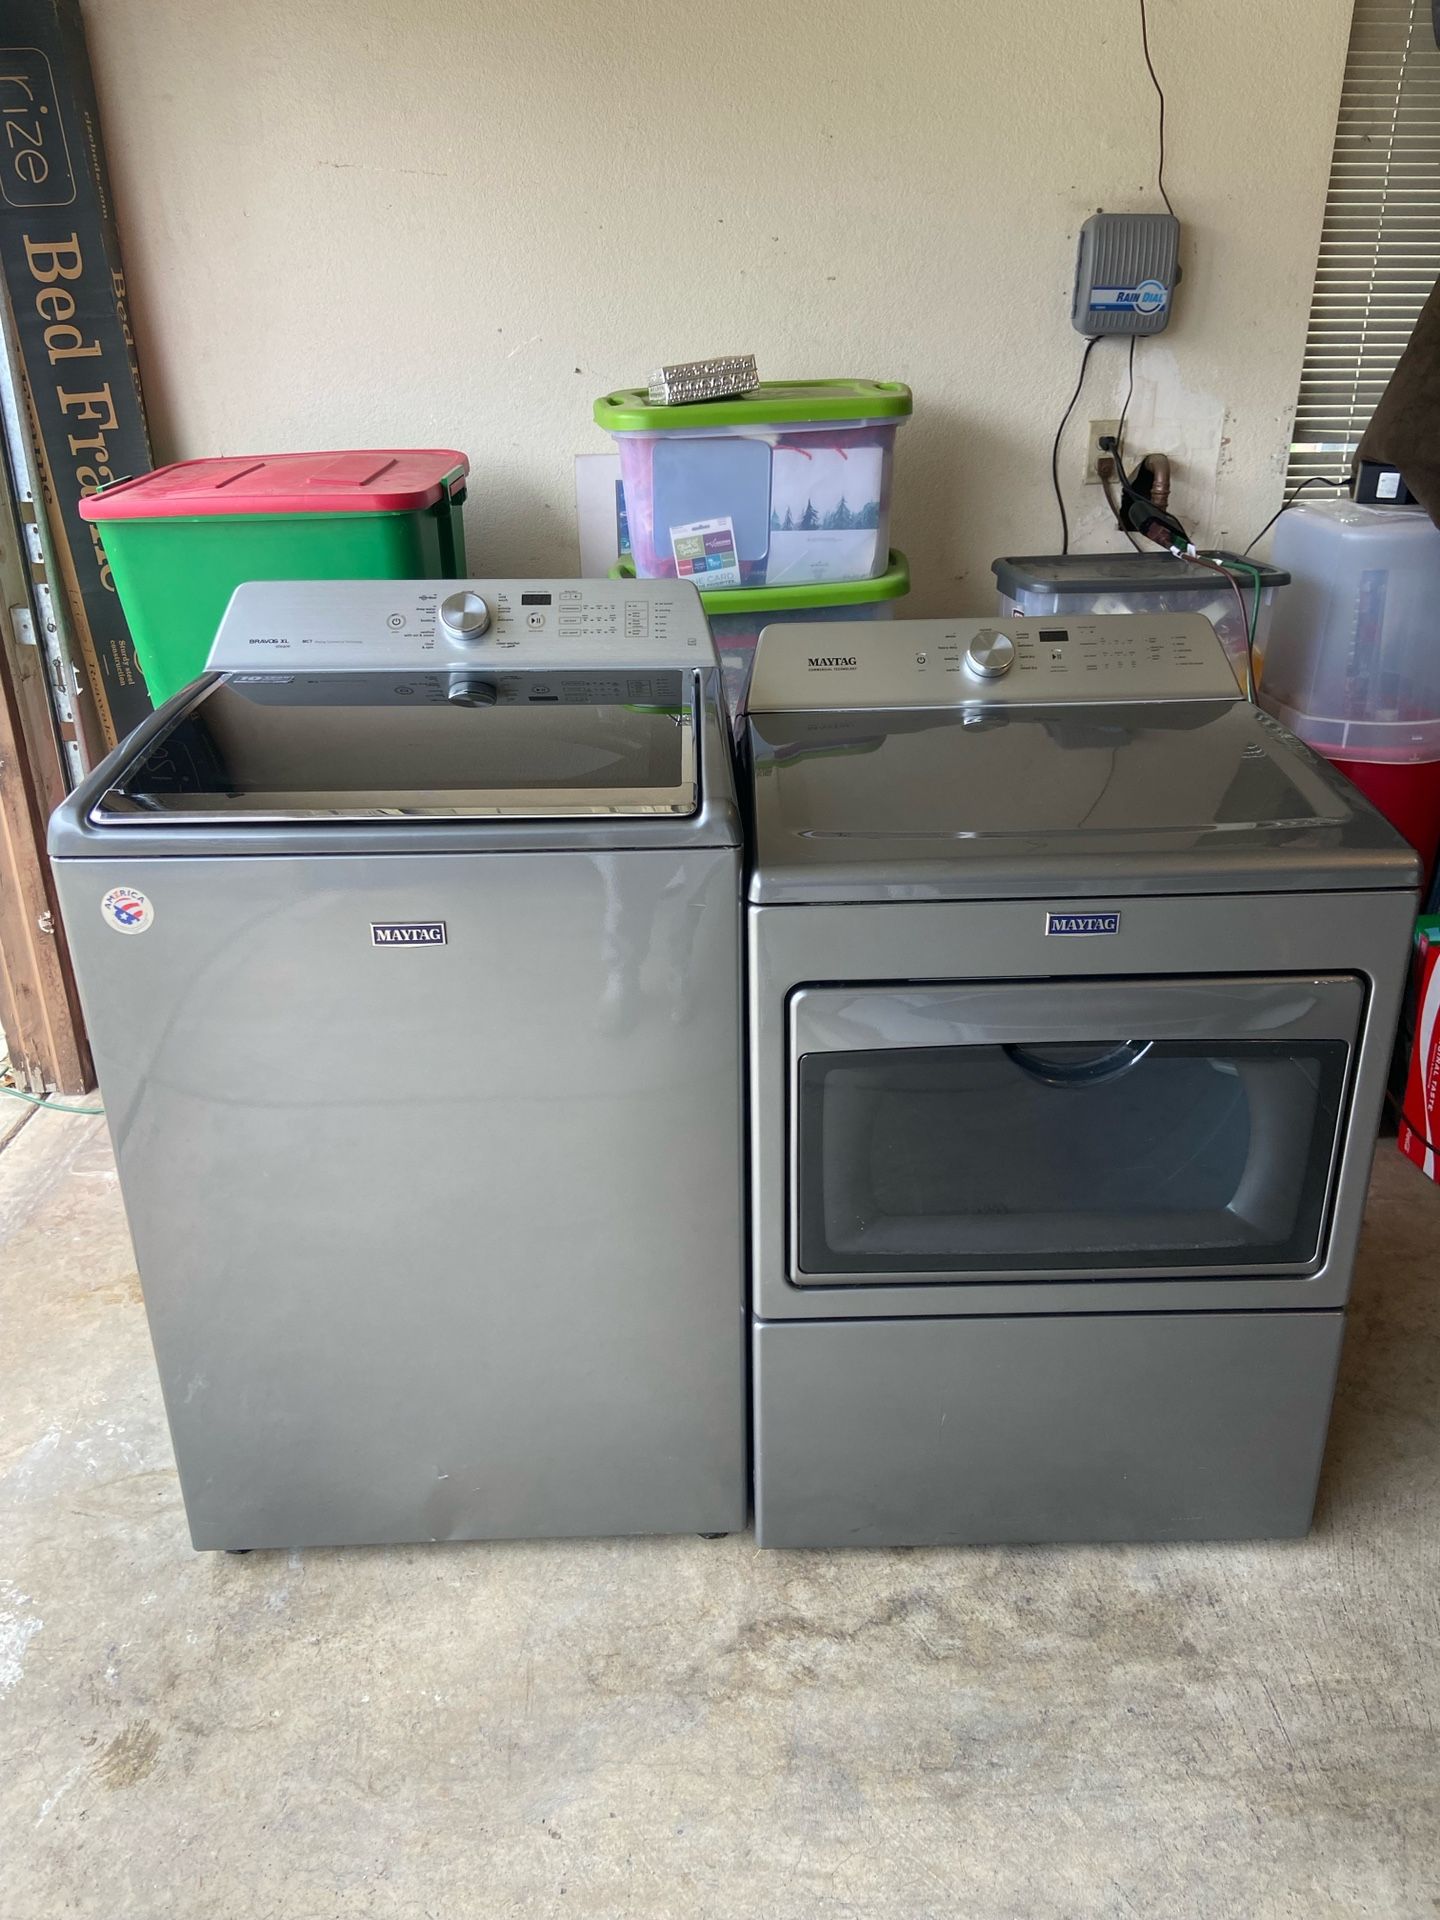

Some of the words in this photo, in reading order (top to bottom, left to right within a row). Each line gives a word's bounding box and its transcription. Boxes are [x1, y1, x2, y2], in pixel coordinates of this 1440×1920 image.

[0, 76, 49, 185] rize
[22, 231, 104, 366] Bed
[111, 267, 135, 347] Bed
[1116, 292, 1140, 302] RAIN
[1142, 292, 1165, 302] DIAL
[56, 382, 120, 593] Fra
[110, 639, 126, 687] construction
[117, 638, 130, 665] Sturdy
[808, 657, 857, 666] MAYTAG
[122, 665, 135, 687] steel
[104, 889, 145, 911] AMERICA
[375, 928, 442, 943] MAYTAG
[1052, 918, 1115, 931] MAYTAG
[1427, 1078, 1438, 1113] TASTE
